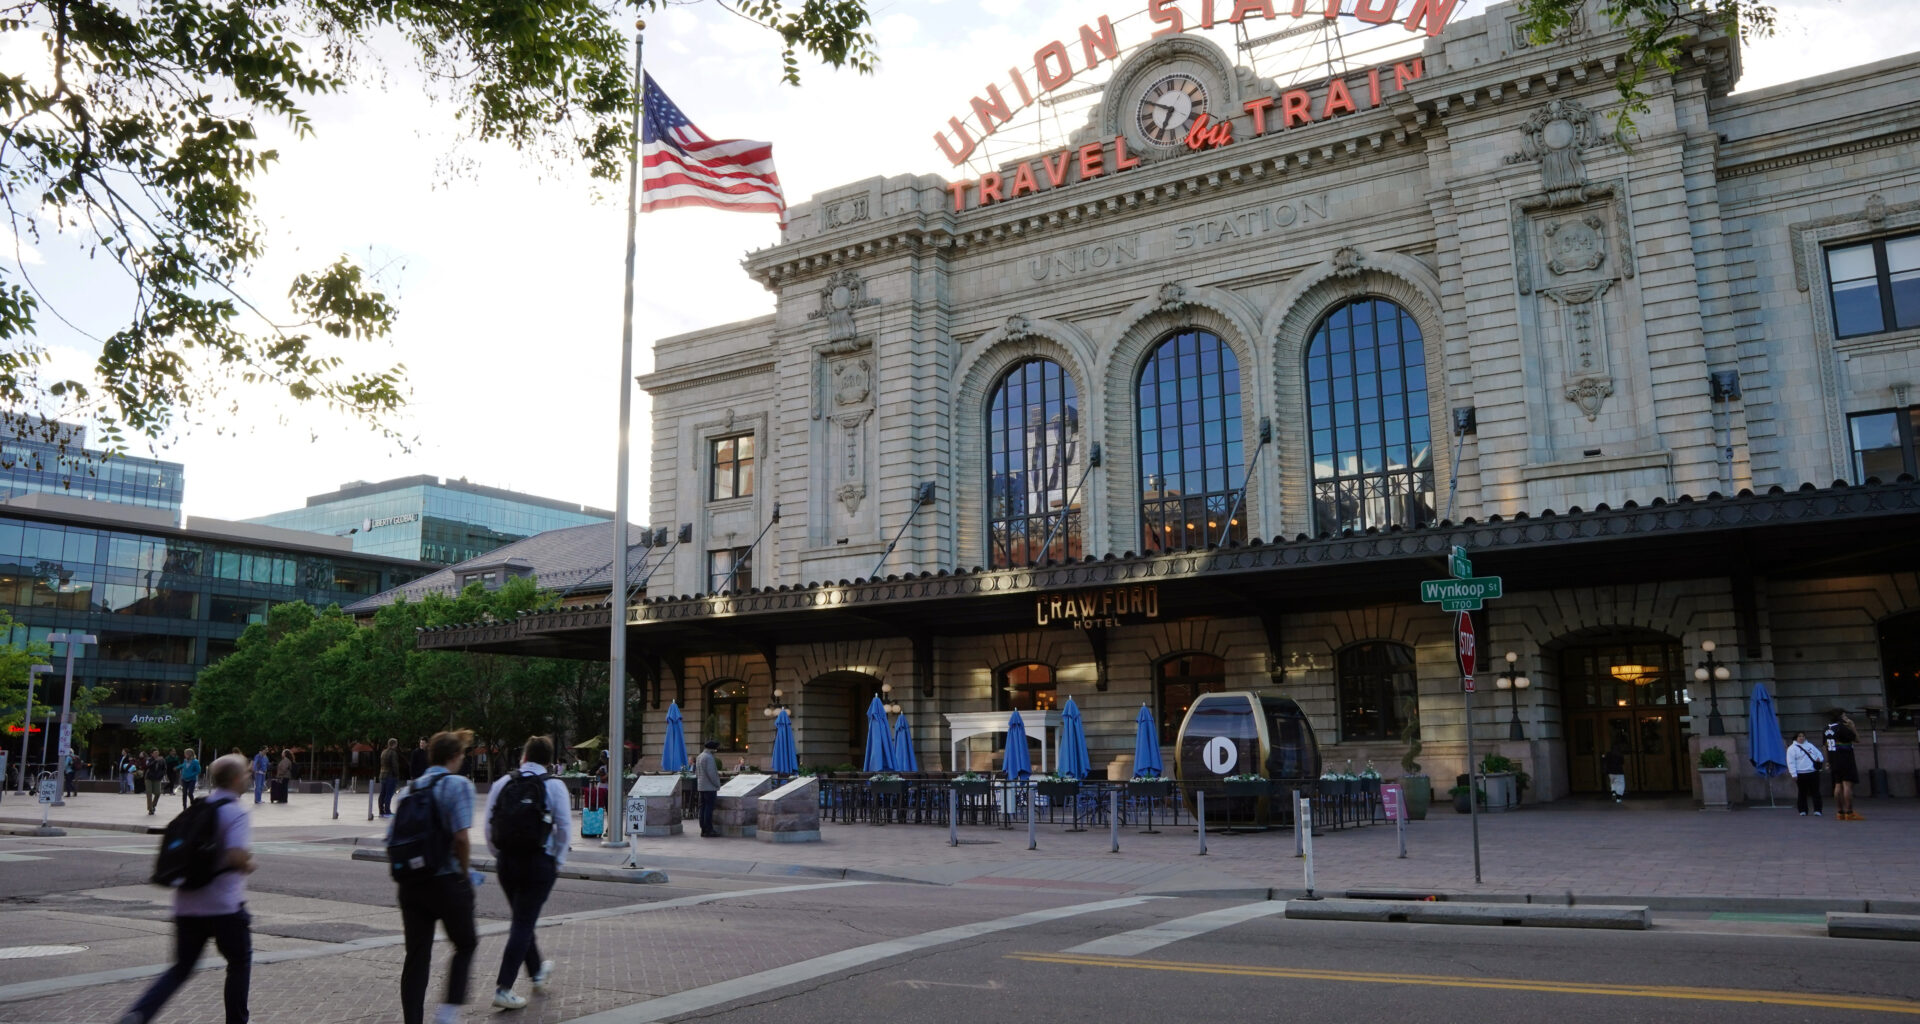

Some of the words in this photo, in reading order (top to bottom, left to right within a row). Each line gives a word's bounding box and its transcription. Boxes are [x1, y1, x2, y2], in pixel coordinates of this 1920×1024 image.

[933, 14, 1118, 168] UNION
[948, 135, 1141, 212] TRAVEL
[1243, 57, 1423, 136] TRAIN
[1028, 235, 1140, 281] UNION
[1174, 194, 1329, 250] STATION
[1426, 583, 1485, 599] Wynkoop
[1488, 583, 1497, 591] St
[1037, 586, 1158, 626] CRAWFORD
[1451, 600, 1472, 609] 1700
[1074, 618, 1121, 630] HOTEL
[1460, 632, 1474, 656] STOP
[131, 714, 164, 724] Antero
